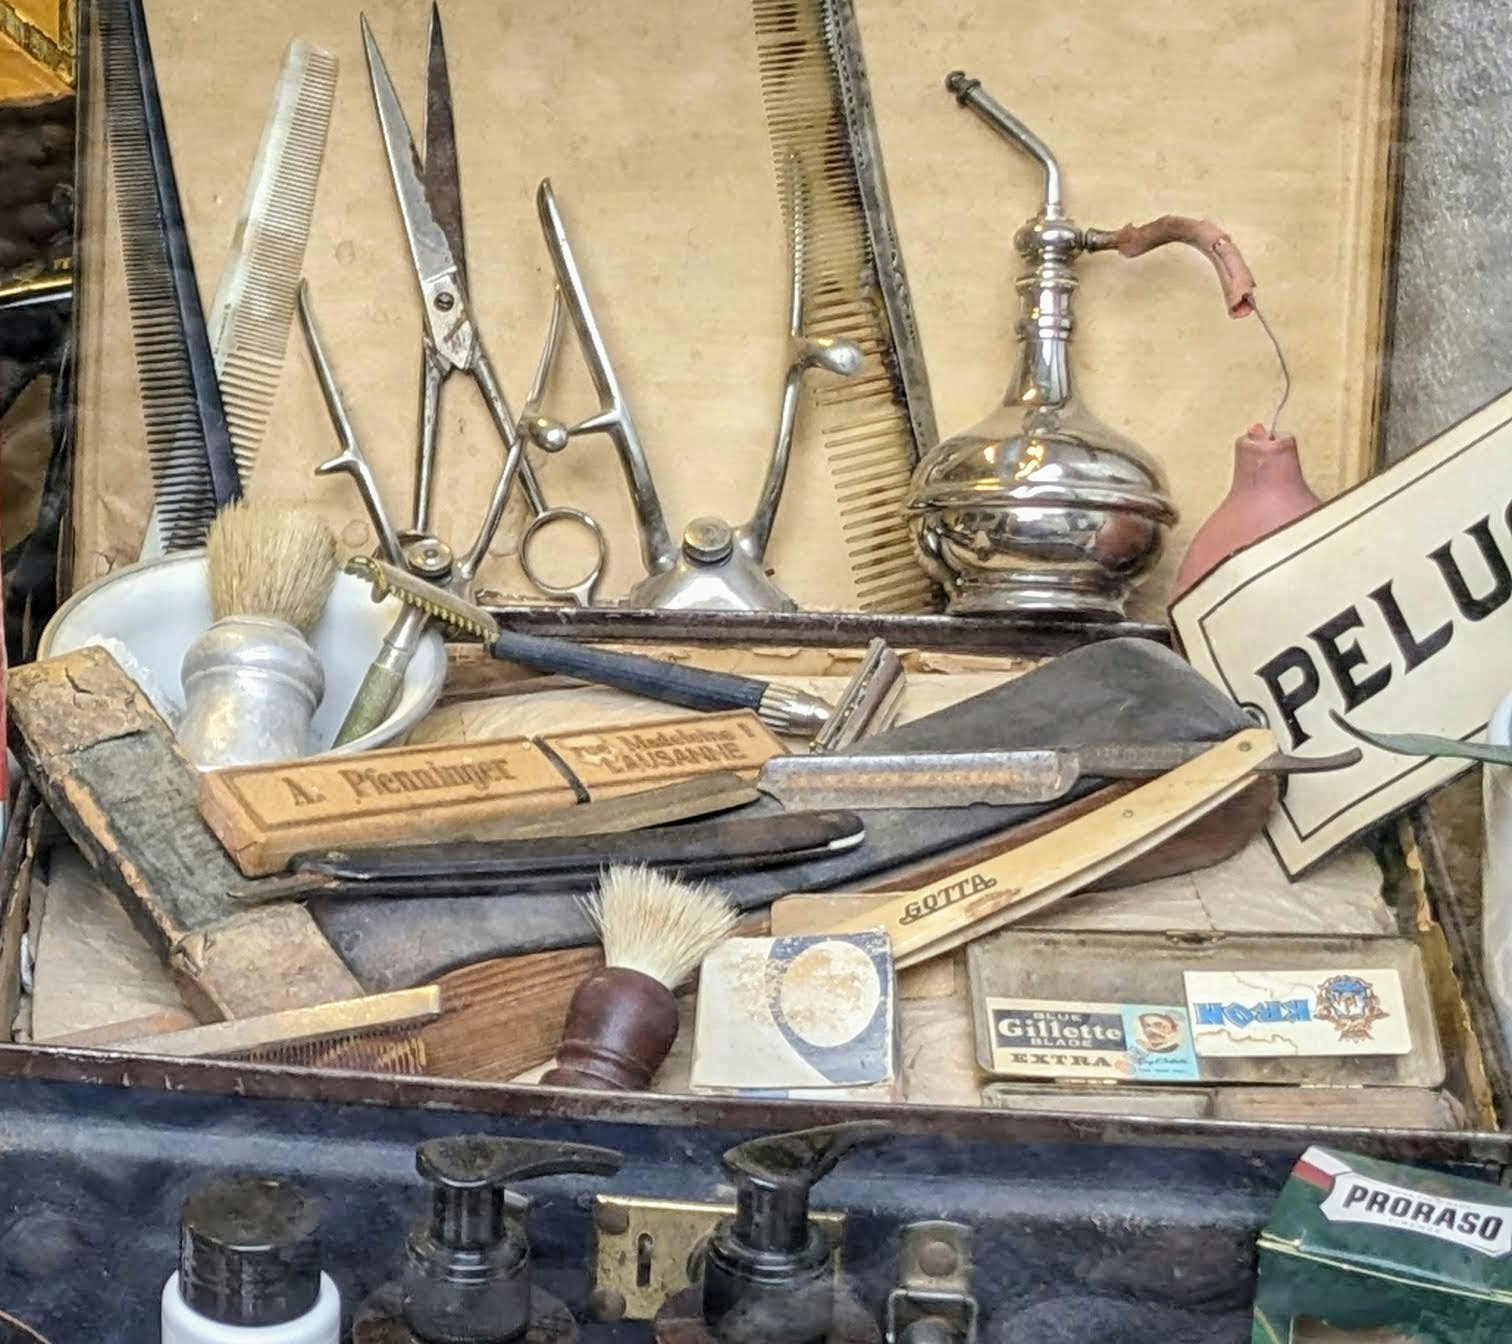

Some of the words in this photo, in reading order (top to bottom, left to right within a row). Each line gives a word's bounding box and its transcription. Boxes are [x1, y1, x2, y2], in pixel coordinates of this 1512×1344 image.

[1254, 499, 1512, 751] PELU
[282, 775, 325, 807] A.
[337, 757, 519, 799] Pfenninger
[898, 873, 997, 925] GOTTA
[997, 1017, 1122, 1041] Gillette
[1010, 1052, 1113, 1068] EXTRA
[1342, 1184, 1504, 1241] PRORASO
